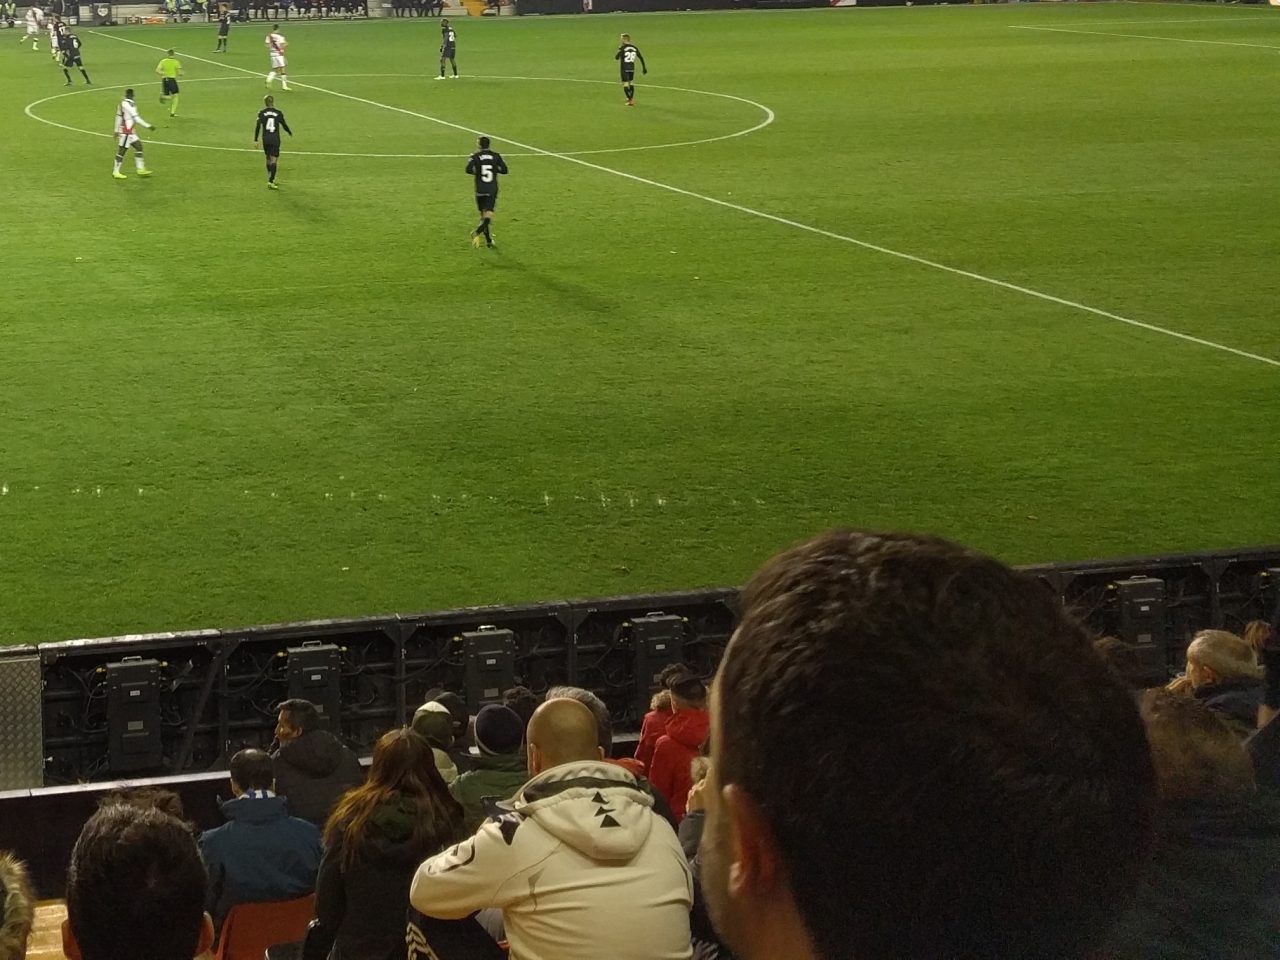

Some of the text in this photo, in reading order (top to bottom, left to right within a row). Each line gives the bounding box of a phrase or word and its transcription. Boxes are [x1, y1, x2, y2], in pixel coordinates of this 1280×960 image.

[624, 51, 637, 63] 28
[265, 117, 276, 133] 4
[480, 164, 494, 183] 5
